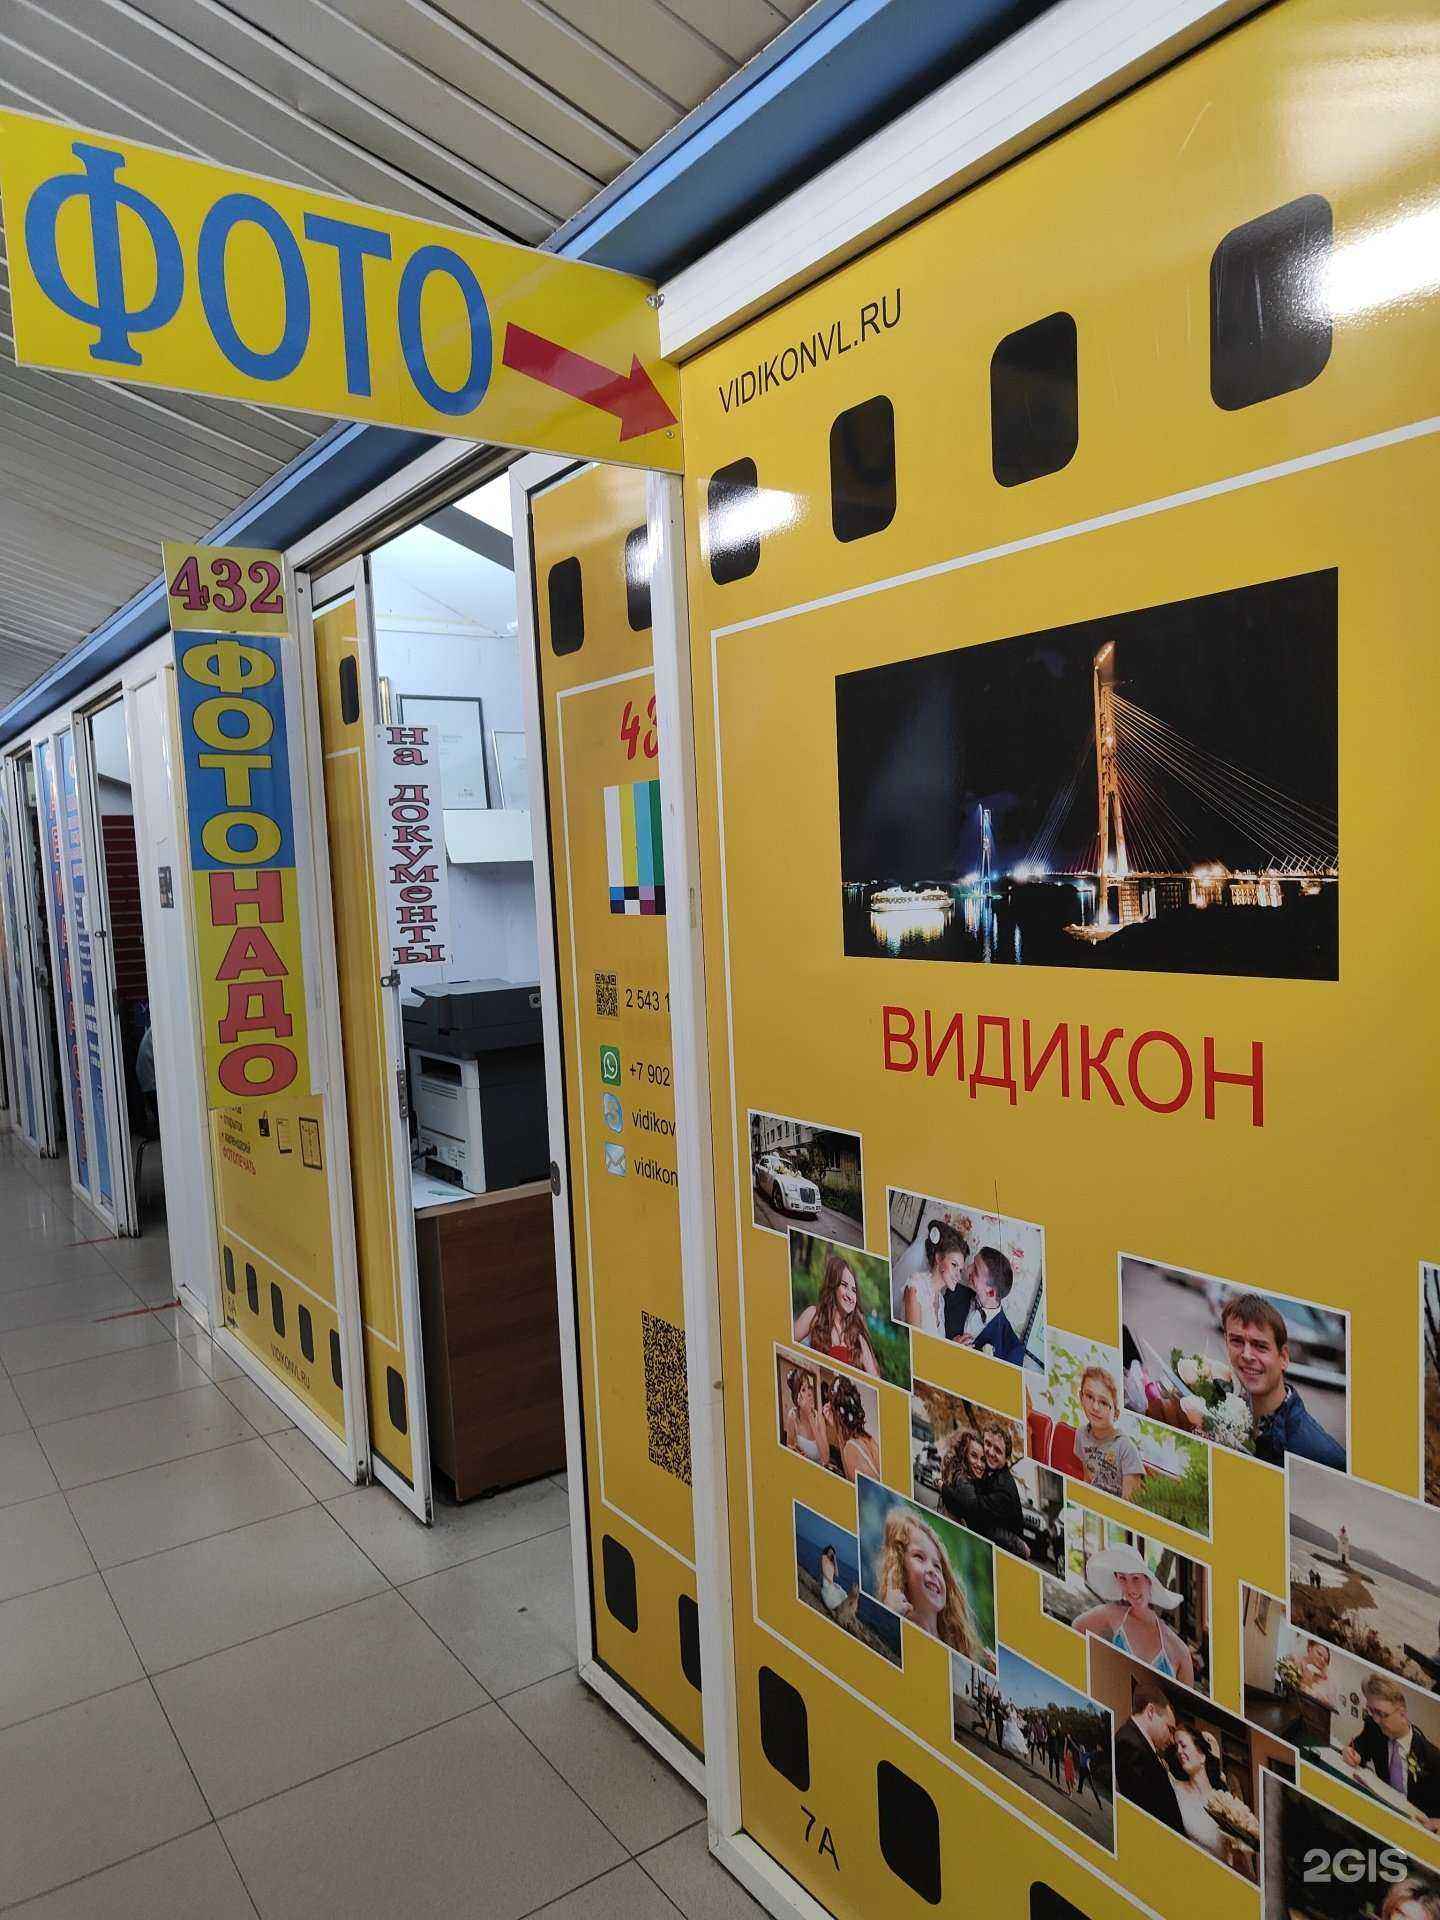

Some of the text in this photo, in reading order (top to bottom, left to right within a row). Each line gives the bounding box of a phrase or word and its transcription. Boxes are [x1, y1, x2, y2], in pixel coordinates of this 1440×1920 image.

[24, 142, 493, 415] ФОТО
[718, 287, 901, 413] VIDIKONVL.RU
[169, 556, 284, 614] 432
[625, 988, 634, 1008] 2
[637, 990, 660, 1012] 543
[629, 1062, 671, 1087] +7 902
[882, 1005, 1264, 1128] ВИДИКОН
